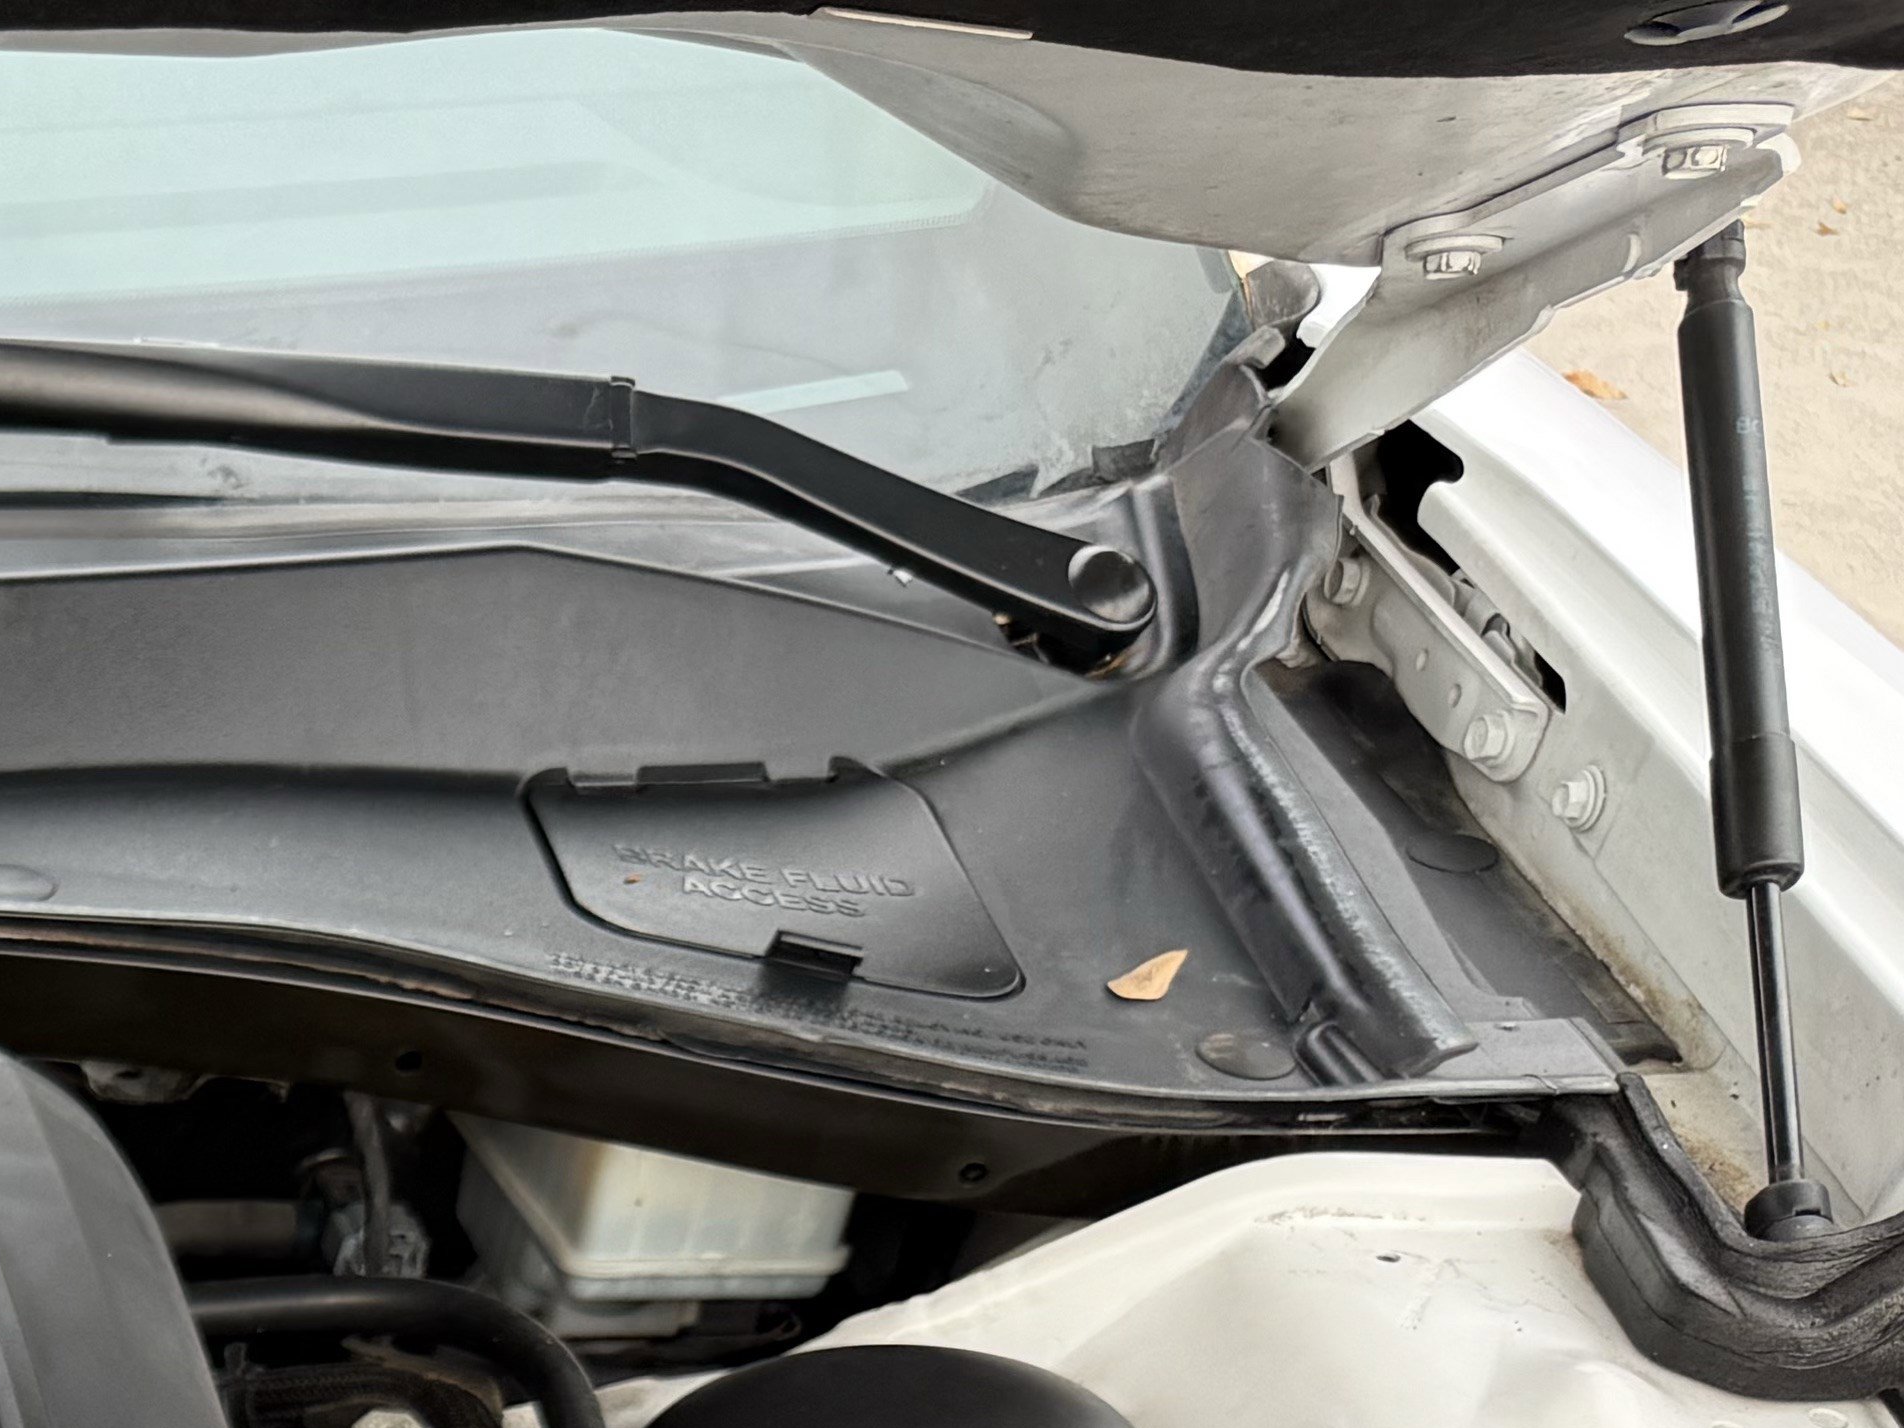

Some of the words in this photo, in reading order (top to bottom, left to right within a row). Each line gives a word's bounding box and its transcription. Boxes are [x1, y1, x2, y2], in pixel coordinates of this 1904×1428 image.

[612, 843, 768, 883] BRAKE
[780, 866, 918, 899] FLUID
[680, 876, 867, 918] ACCESS
